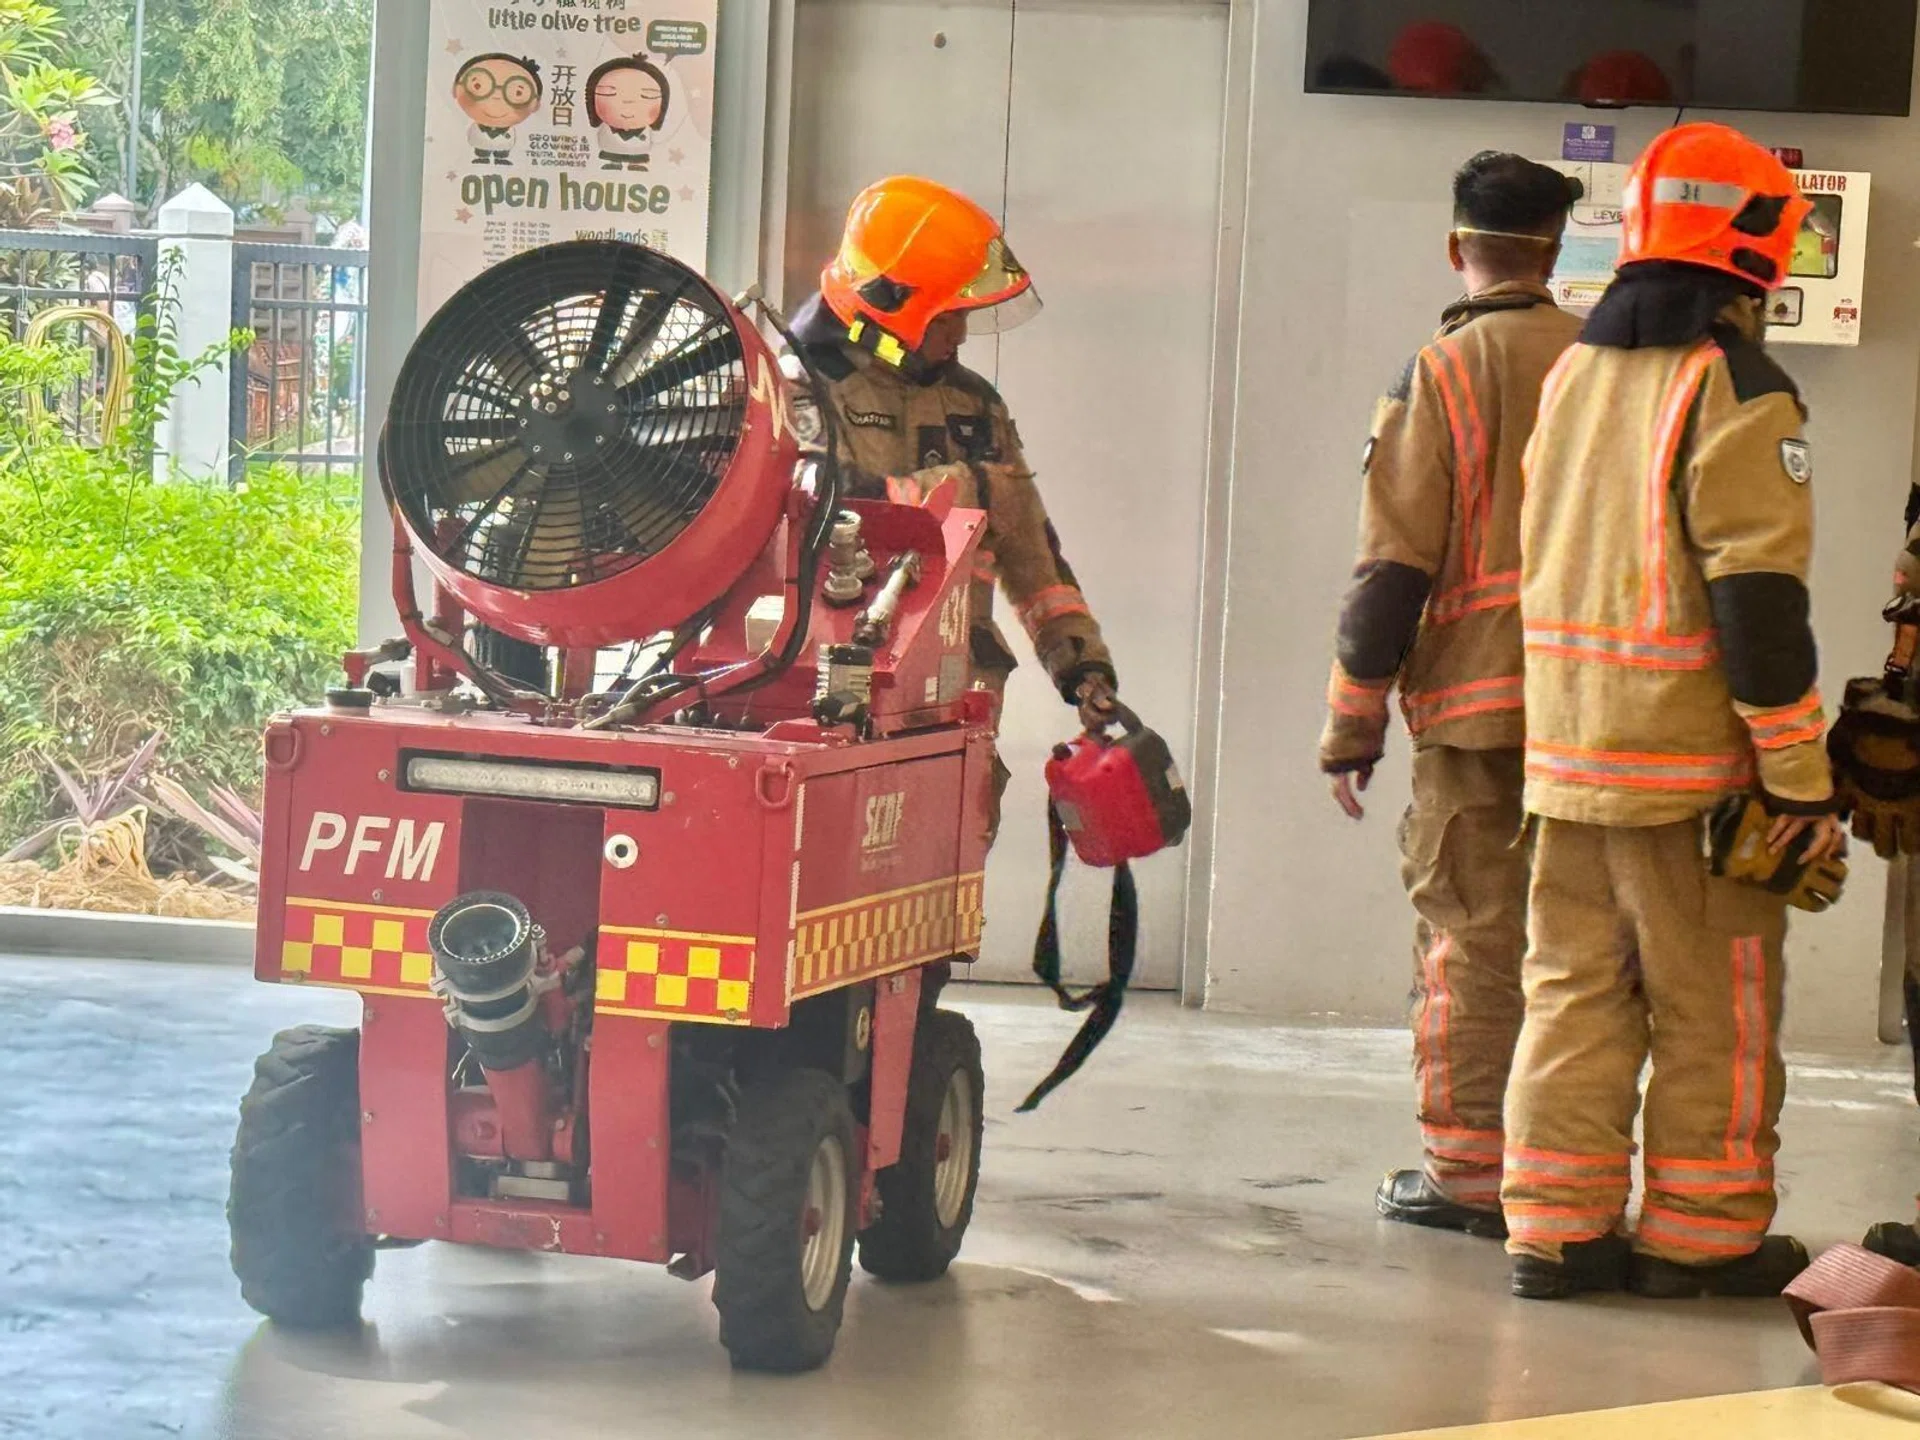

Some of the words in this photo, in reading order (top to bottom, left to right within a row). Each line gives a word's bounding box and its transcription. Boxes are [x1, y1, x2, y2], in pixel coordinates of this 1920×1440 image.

[488, 7, 537, 30] little
[541, 10, 589, 33] olive
[593, 14, 641, 34] tree
[550, 64, 577, 127] 开放日
[461, 174, 549, 215] open
[559, 172, 671, 214] house
[299, 811, 445, 882] PFM
